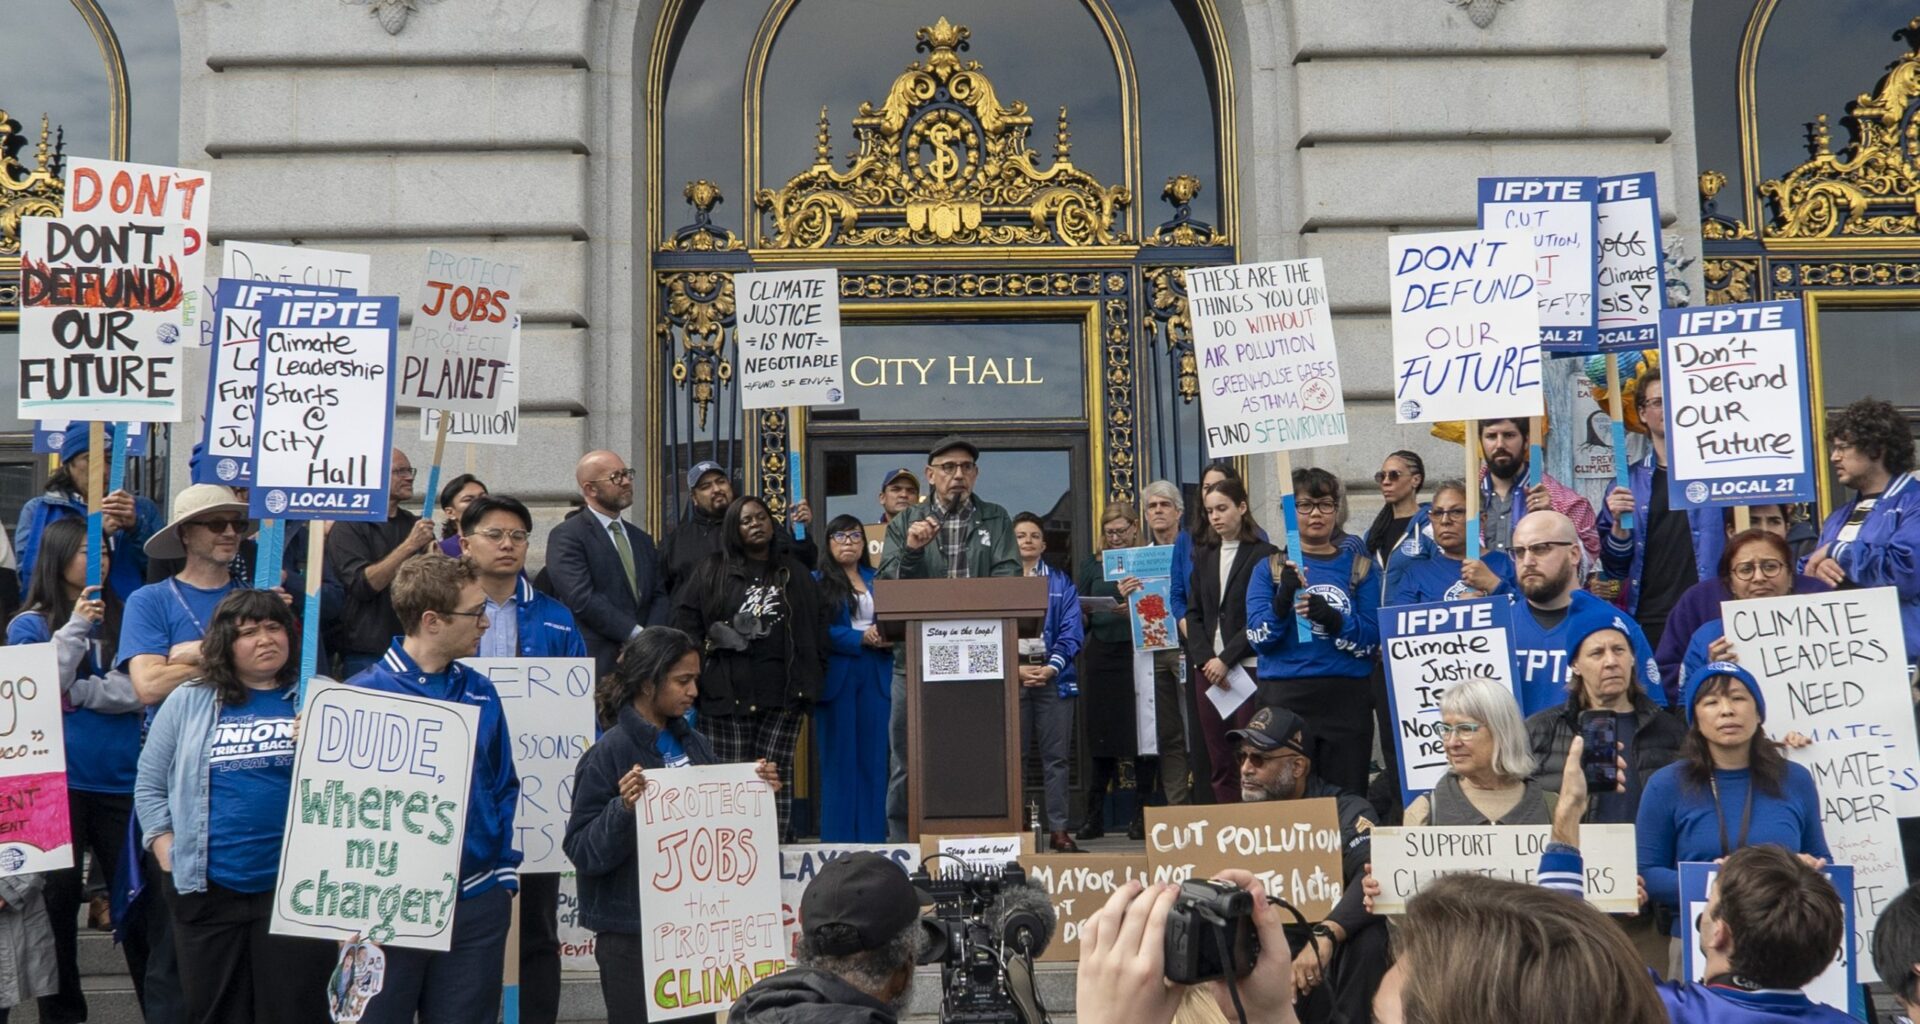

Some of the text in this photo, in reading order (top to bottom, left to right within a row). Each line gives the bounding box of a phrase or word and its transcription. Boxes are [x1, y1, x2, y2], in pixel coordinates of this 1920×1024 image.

[73, 166, 205, 220] DON'T
[1494, 181, 1583, 201] IFPTE
[47, 221, 165, 264] DON'T
[1396, 238, 1508, 276] DON'T
[427, 249, 521, 287] PROTECT
[1189, 262, 1311, 293] THESE ARE THE
[21, 264, 177, 308] DEFUND
[421, 280, 511, 323] JOBS
[749, 279, 826, 301] CLIMATE
[1192, 286, 1326, 317] THINGS YOU CAN
[1401, 273, 1534, 313] DEFUND
[278, 302, 382, 326] IFPTE
[743, 303, 822, 326] JUSTICE
[1213, 308, 1313, 338] DO WITHOUT
[1678, 306, 1784, 335] IFPTE
[52, 309, 138, 352] OUR
[267, 332, 357, 354] Climate
[1425, 322, 1499, 350] OUR
[1567, 330, 1583, 341] 21
[1639, 328, 1655, 340] 21
[744, 354, 839, 375] NEGOTIABLE
[1204, 333, 1316, 369] AIR POLLUTION
[1674, 337, 1758, 368] Don't
[20, 353, 175, 400] FUTURE
[277, 357, 385, 380] Leadership
[401, 355, 507, 401] PLANET
[781, 379, 796, 387] SF
[947, 355, 1044, 385] HALL
[1211, 360, 1336, 397] GREENHOUSE GASES
[1397, 344, 1541, 399] FUTURE
[1688, 364, 1788, 395] Defund
[264, 382, 340, 405] Starts
[1241, 392, 1300, 413] ASTHMA
[303, 406, 328, 431] @
[262, 430, 325, 460] City
[1207, 422, 1251, 448] FUND
[1696, 430, 1795, 460] Future
[308, 455, 367, 486] Hall
[290, 491, 371, 509] LOCAL 21
[1711, 478, 1795, 496] LOCAL 21
[927, 626, 948, 639] Stay
[1397, 603, 1493, 635] IFPTE
[1733, 602, 1869, 641] CLIMATE
[1391, 634, 1491, 660] Climate
[1760, 639, 1889, 678] LEADERS
[1420, 658, 1502, 683] Justice
[1787, 681, 1865, 720] NEED
[317, 703, 446, 784] DUDE,
[300, 778, 457, 846] Where's
[642, 778, 769, 825] PROTECT
[1151, 820, 1209, 852] CUT
[1405, 831, 1499, 857] SUPPORT
[345, 838, 399, 878] my
[652, 827, 759, 891] JOBS
[1030, 864, 1120, 896] MAYOR
[289, 869, 457, 943] charger?
[684, 891, 732, 917] that
[653, 912, 778, 962] PROTECT
